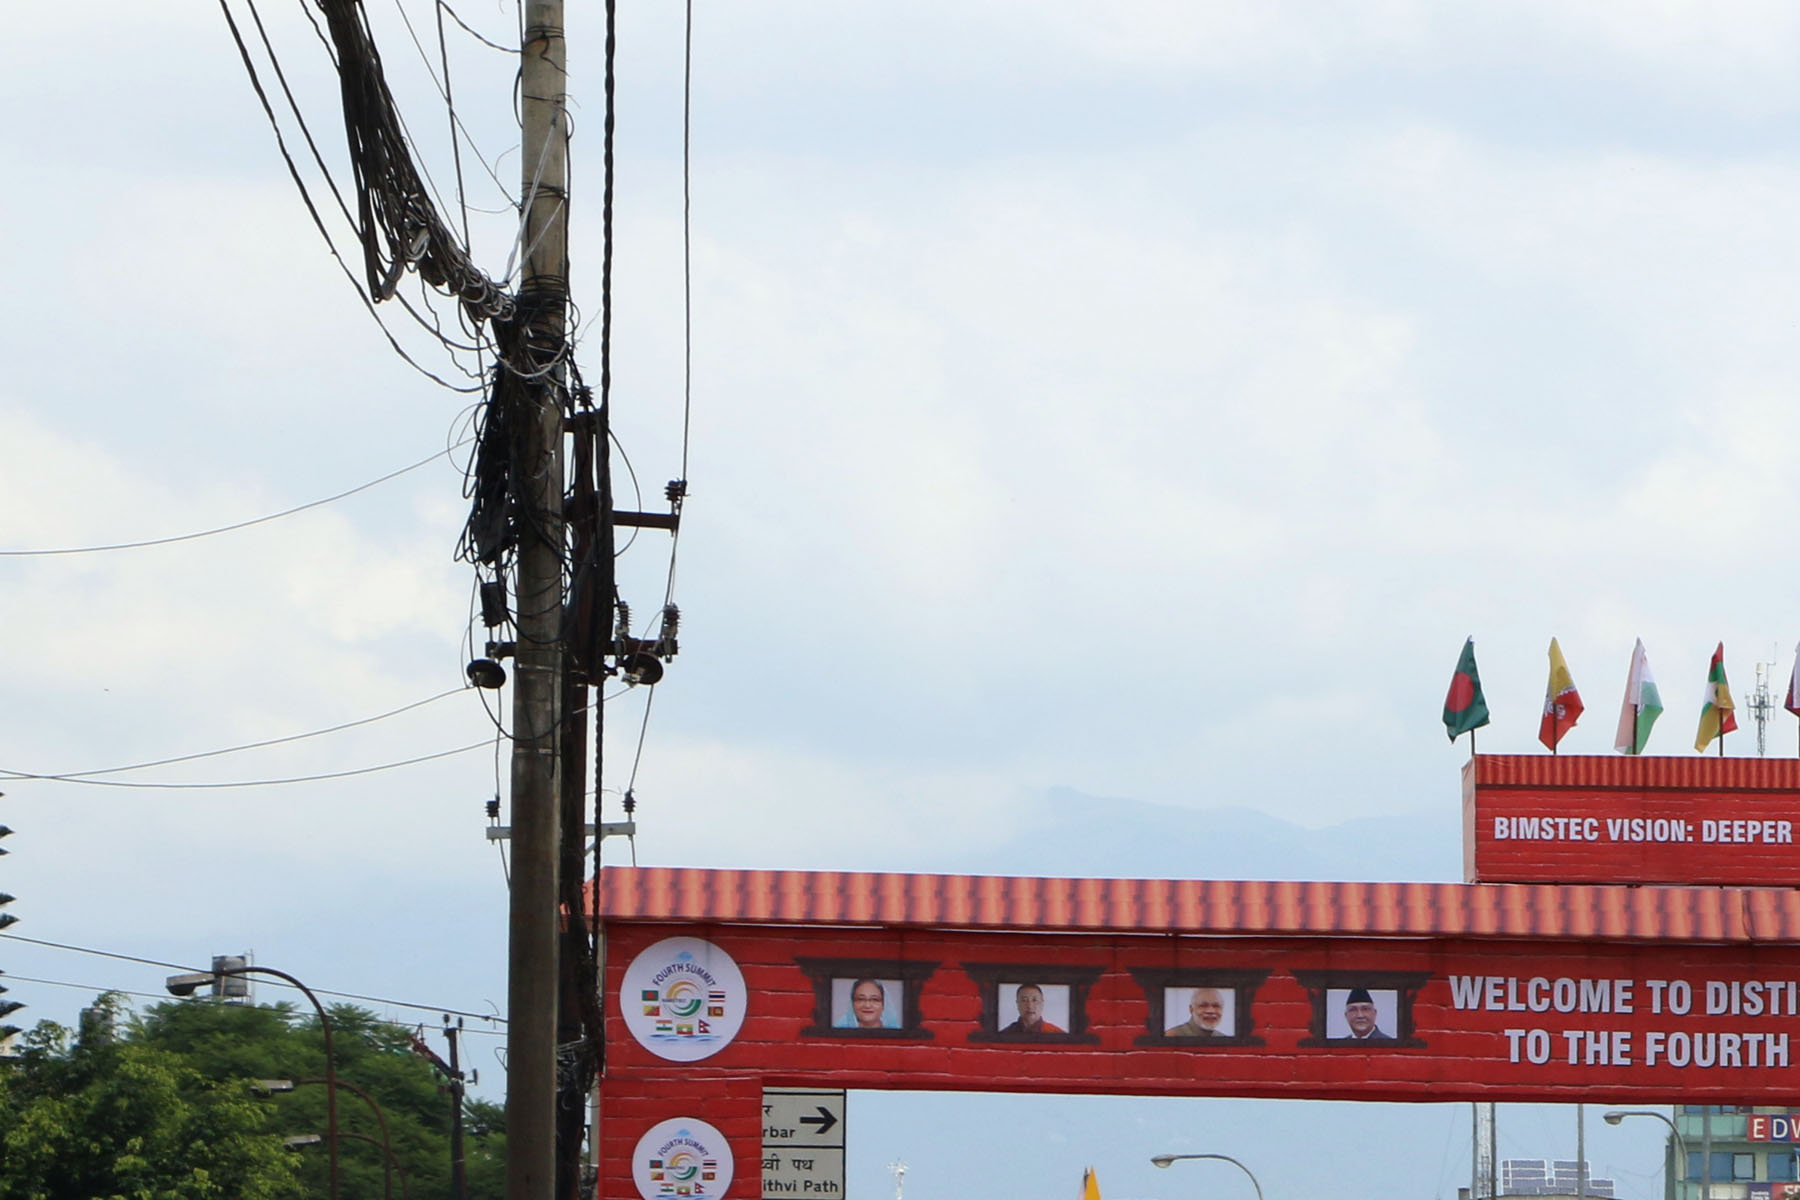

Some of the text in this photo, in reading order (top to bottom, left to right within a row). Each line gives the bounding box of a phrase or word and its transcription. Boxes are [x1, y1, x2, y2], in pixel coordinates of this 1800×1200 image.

[1494, 816, 1599, 841] BIMSTEC
[1606, 818, 1694, 842] VISION:
[1702, 819, 1793, 843] DEEPER
[652, 963, 717, 987] FOURTH SUMMIT
[1449, 975, 1633, 1014] WELCOME
[1646, 980, 1692, 1015] TO
[1504, 1028, 1550, 1065] TO
[1562, 1030, 1632, 1066] THE
[1645, 1031, 1789, 1067] FOURTH
[762, 1126, 796, 1138] rbar
[792, 1159, 814, 1170] पथ
[763, 1180, 838, 1192] ithvi Path
